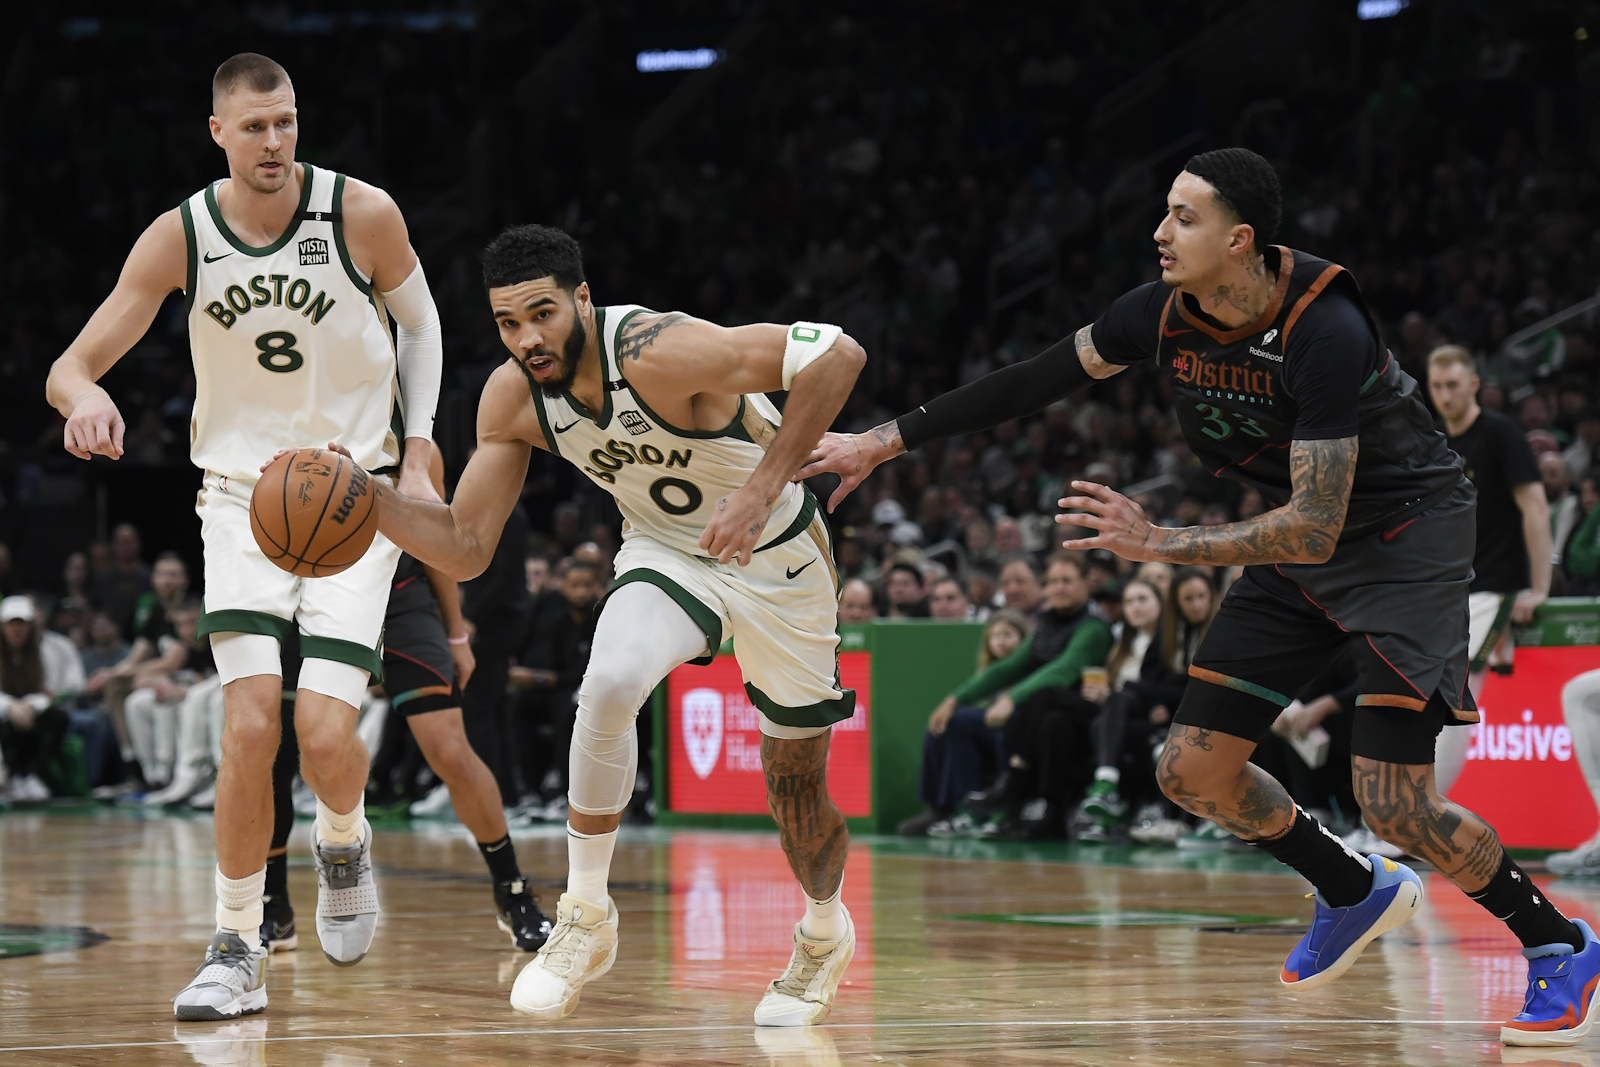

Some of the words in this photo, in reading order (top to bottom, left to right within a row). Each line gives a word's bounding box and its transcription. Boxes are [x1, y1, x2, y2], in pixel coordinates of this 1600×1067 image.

[314, 212, 323, 221] 6
[299, 239, 328, 254] VISTA
[300, 252, 329, 265] PRINT
[203, 273, 337, 331] BOSTON
[254, 330, 305, 374] 8
[1172, 356, 1190, 371] the
[1249, 346, 1284, 363] Robinhood
[1174, 347, 1275, 397] District
[619, 412, 645, 428] VISTA
[626, 421, 651, 436] PRINT
[1194, 402, 1270, 442] 33
[584, 438, 693, 485] BOSTON
[648, 475, 704, 516] 0
[1466, 707, 1573, 762] clusive
